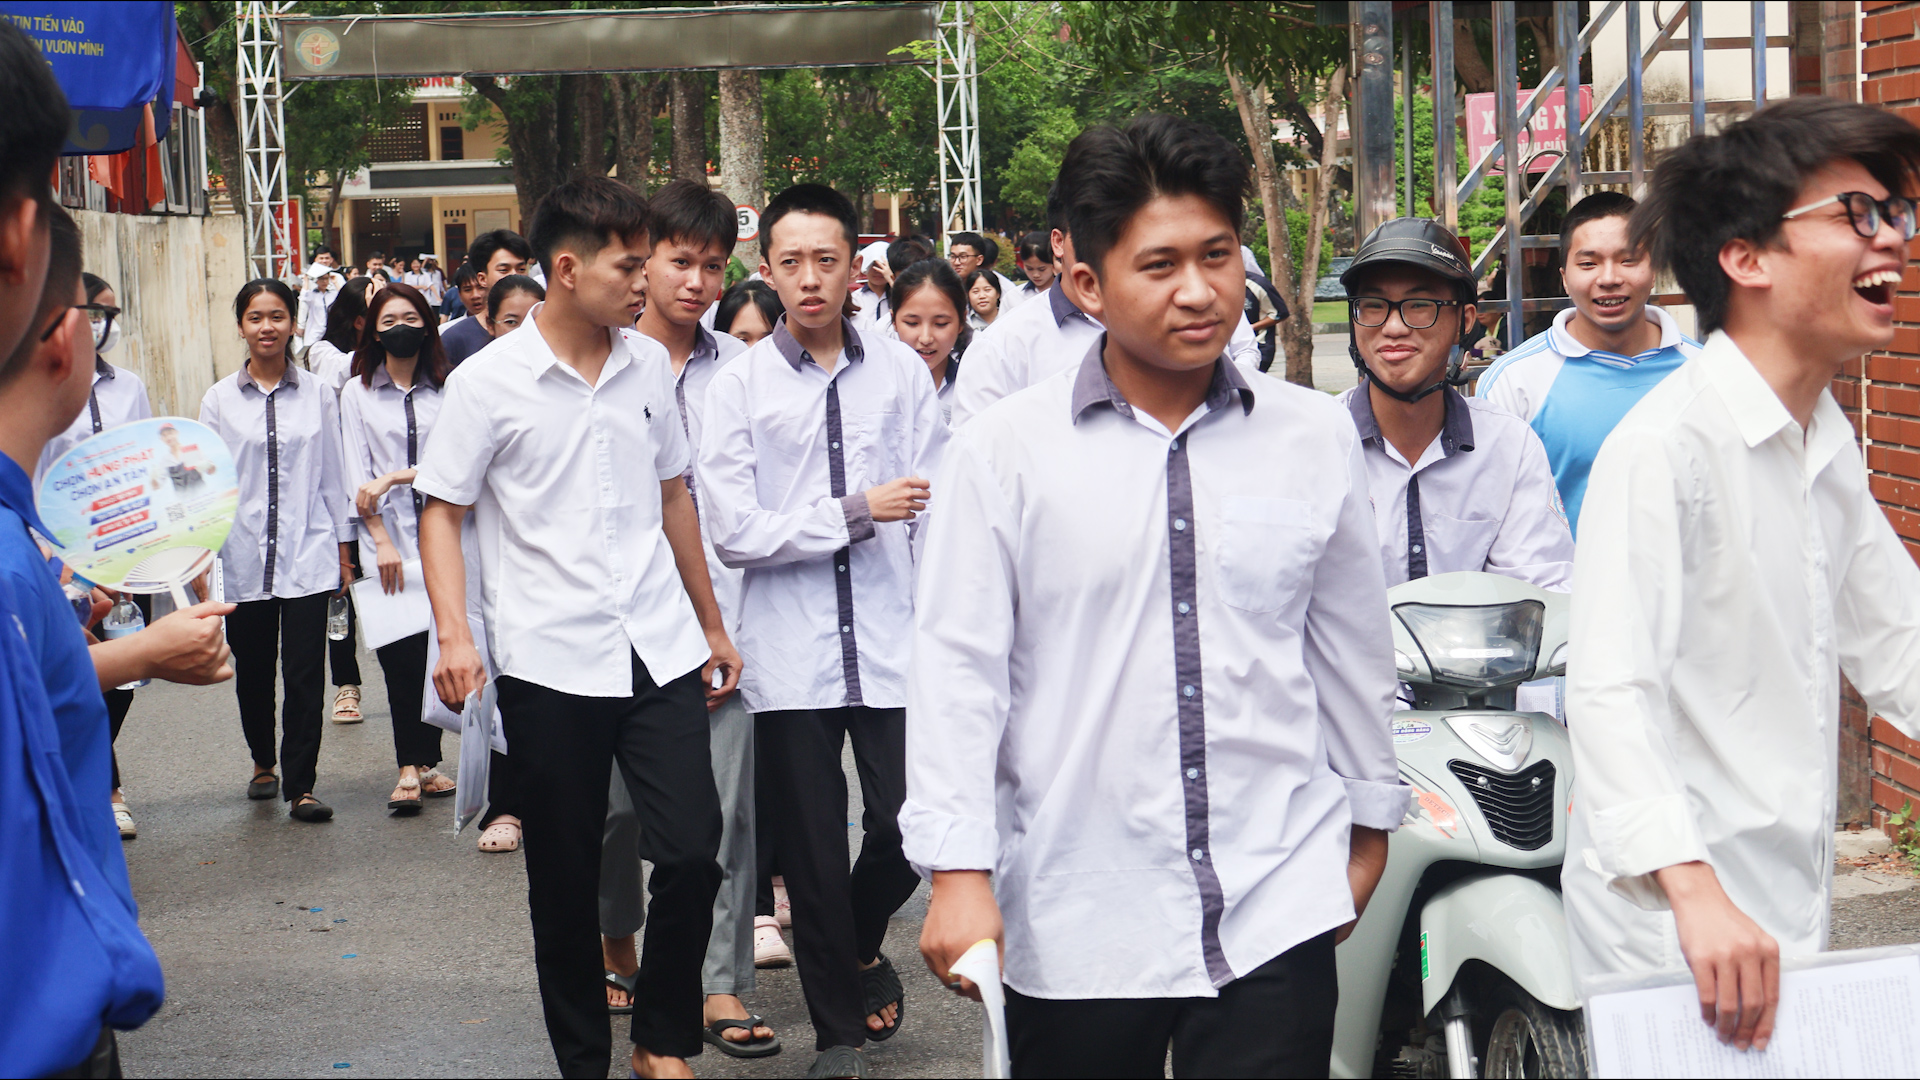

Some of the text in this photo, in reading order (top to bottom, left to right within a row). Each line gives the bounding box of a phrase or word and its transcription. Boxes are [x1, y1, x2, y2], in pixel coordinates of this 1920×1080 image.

[33, 13, 59, 32] TIẾN
[61, 16, 85, 34] VÀO
[78, 39, 104, 57] MÌNH
[738, 210, 750, 226] 5
